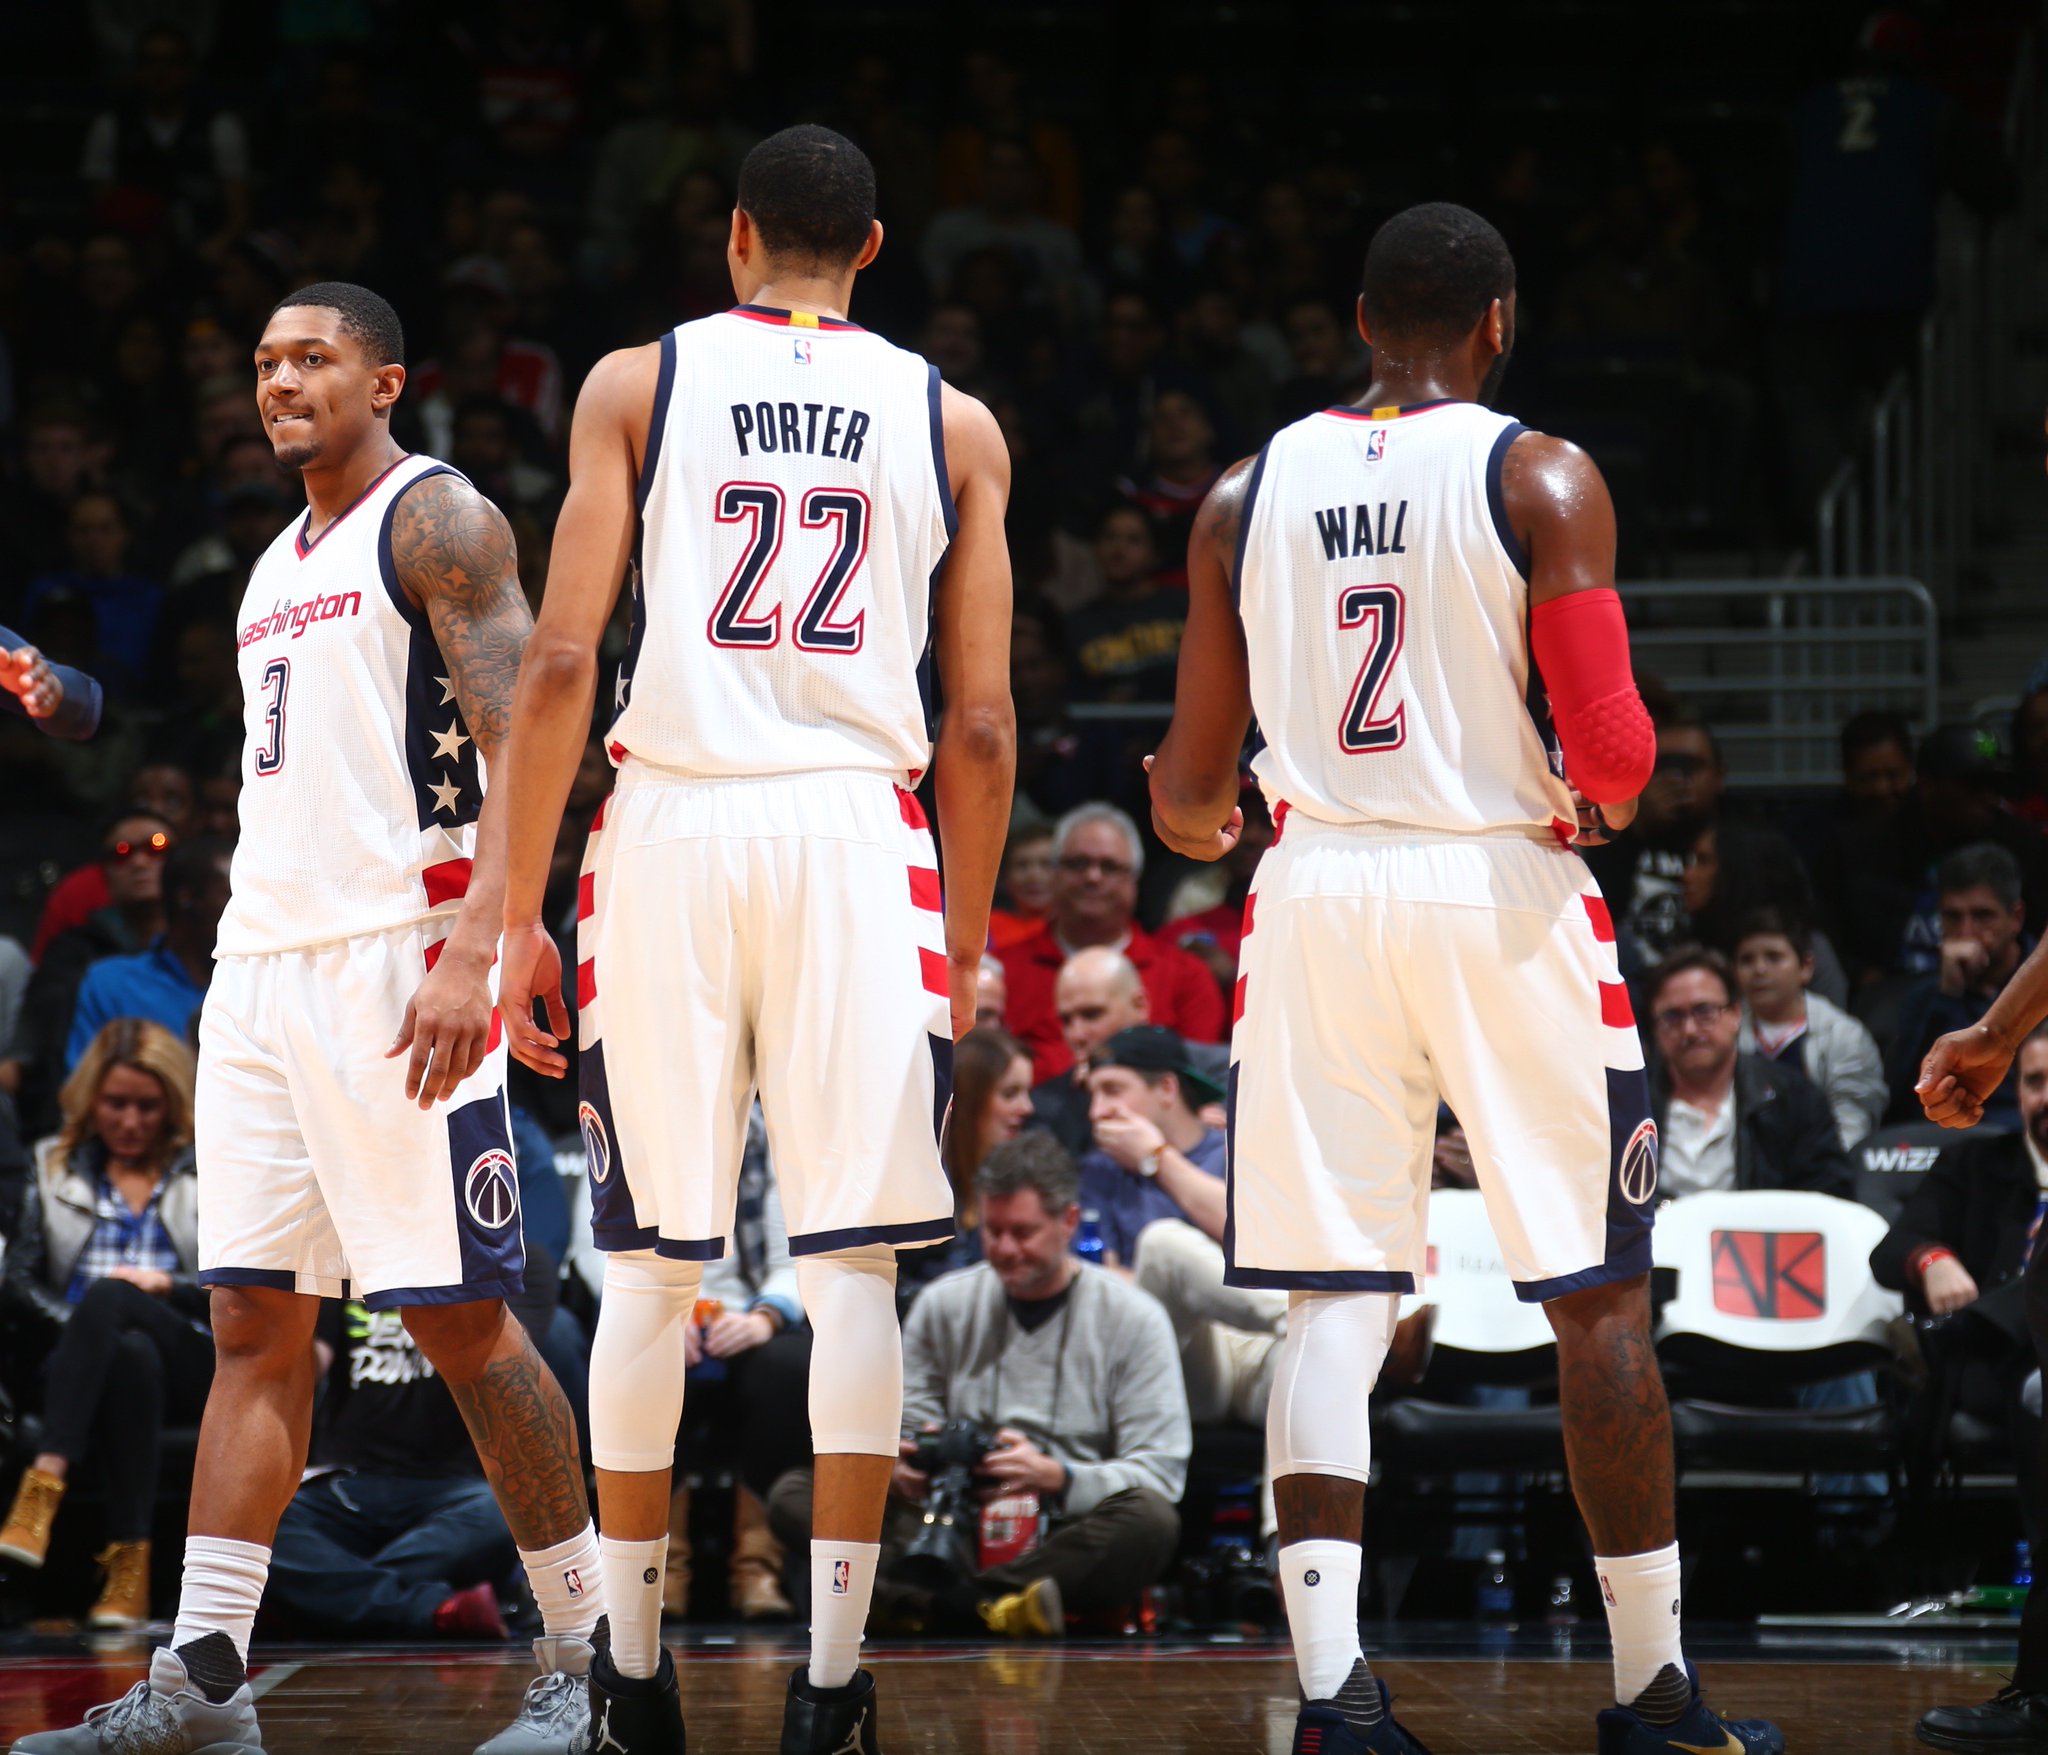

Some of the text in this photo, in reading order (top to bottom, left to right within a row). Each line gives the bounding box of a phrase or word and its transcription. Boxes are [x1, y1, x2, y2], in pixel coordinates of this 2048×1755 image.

[731, 402, 870, 463] PORTER
[707, 481, 871, 655] 22
[1315, 500, 1408, 561] WALL
[256, 657, 290, 777] 3
[1338, 583, 1406, 755] 2
